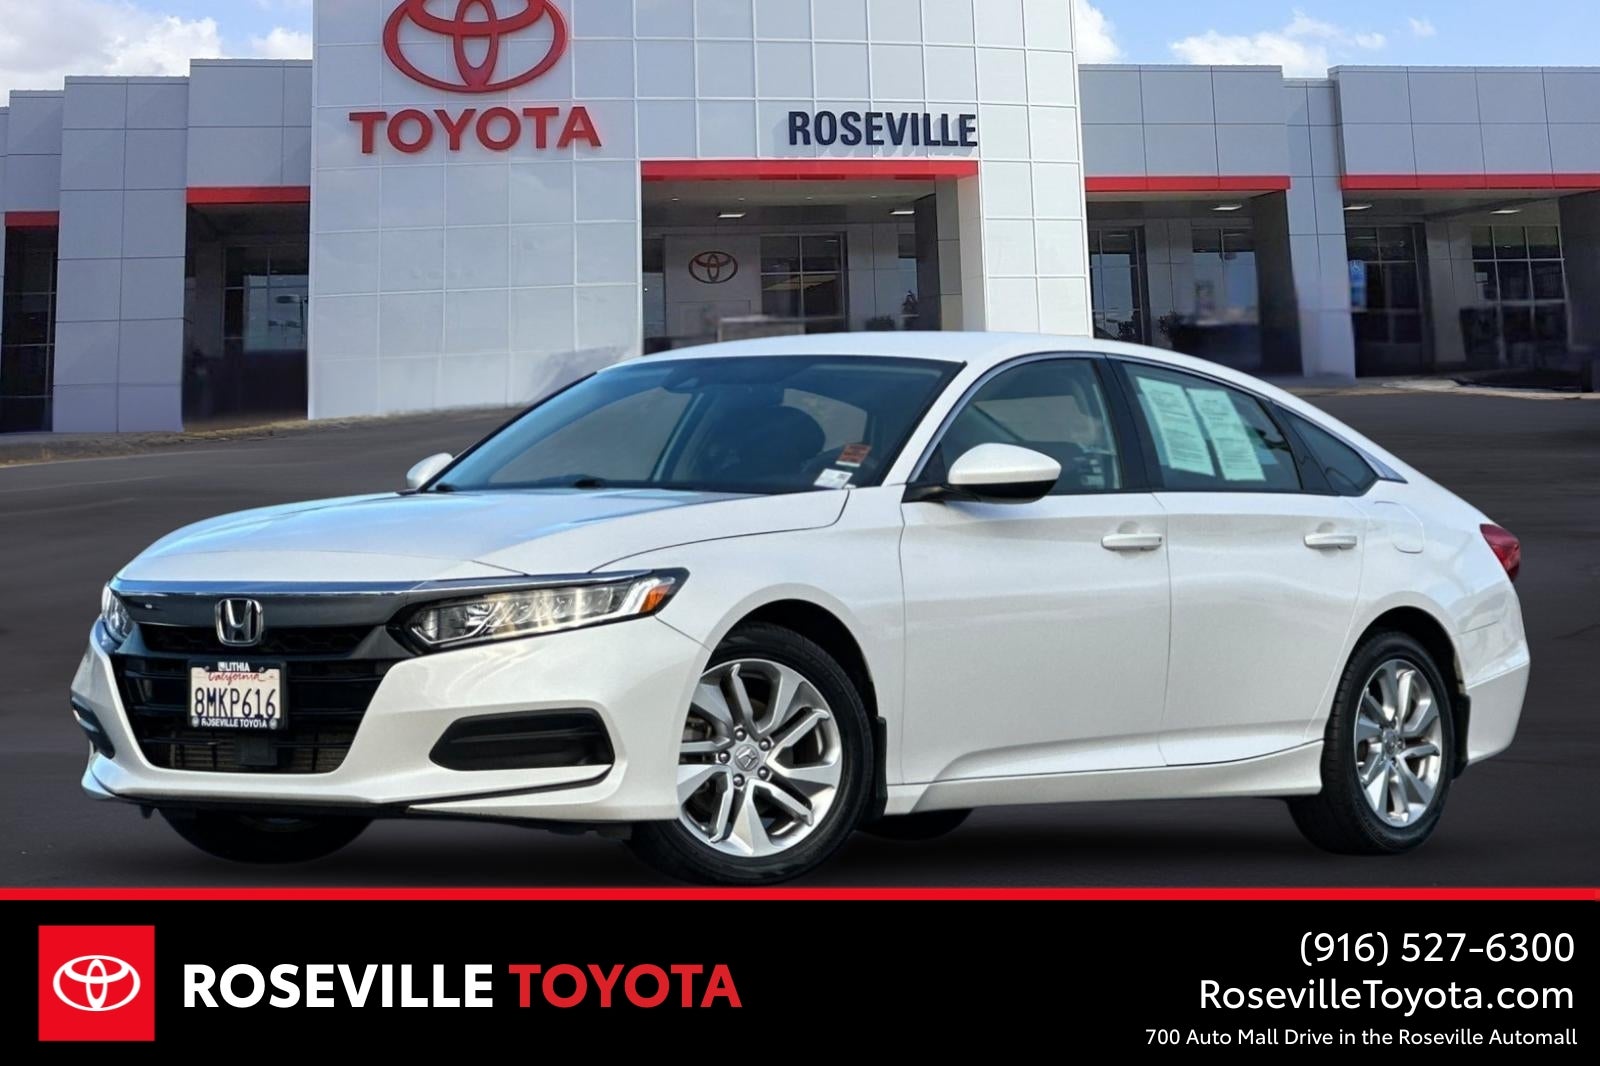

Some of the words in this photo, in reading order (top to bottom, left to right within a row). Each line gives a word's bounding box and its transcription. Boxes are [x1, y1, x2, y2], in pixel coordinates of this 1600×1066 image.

[349, 105, 602, 154] TOYOTA
[788, 110, 978, 148] ROSEVILLE
[225, 662, 250, 672] LITHIA
[208, 672, 264, 686] California
[195, 688, 276, 718] 8MKP616
[202, 718, 238, 728] ROSEVILLE
[240, 719, 267, 728] TOYOTA
